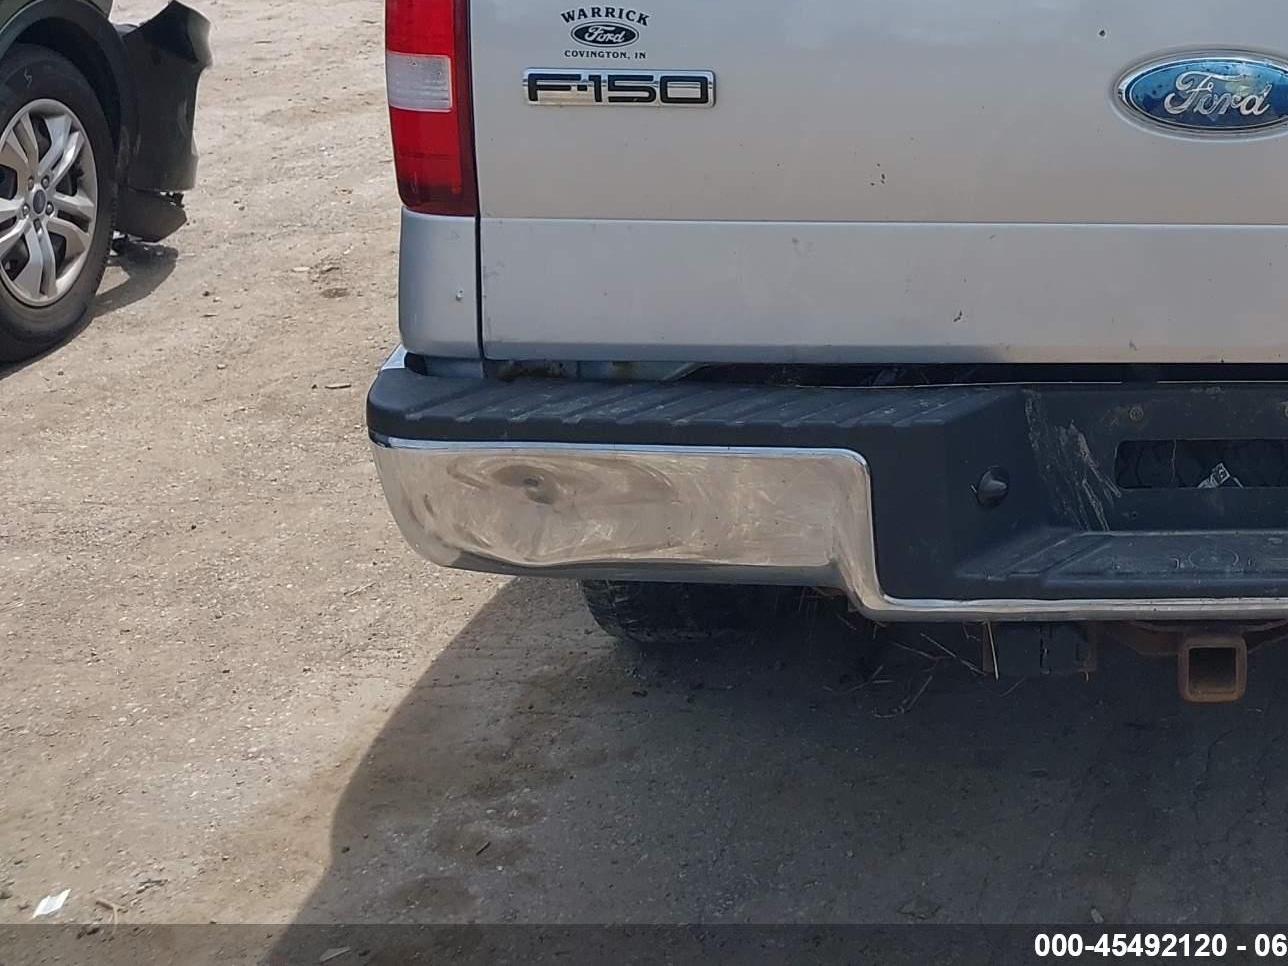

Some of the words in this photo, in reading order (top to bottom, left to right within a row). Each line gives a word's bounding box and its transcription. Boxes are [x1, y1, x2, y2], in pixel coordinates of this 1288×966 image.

[561, 6, 651, 26] WARRICK
[584, 25, 626, 43] Ford
[564, 49, 631, 60] COVINGTON,
[634, 51, 647, 60] IN
[527, 73, 709, 104] F-150
[1163, 70, 1273, 116] Ford
